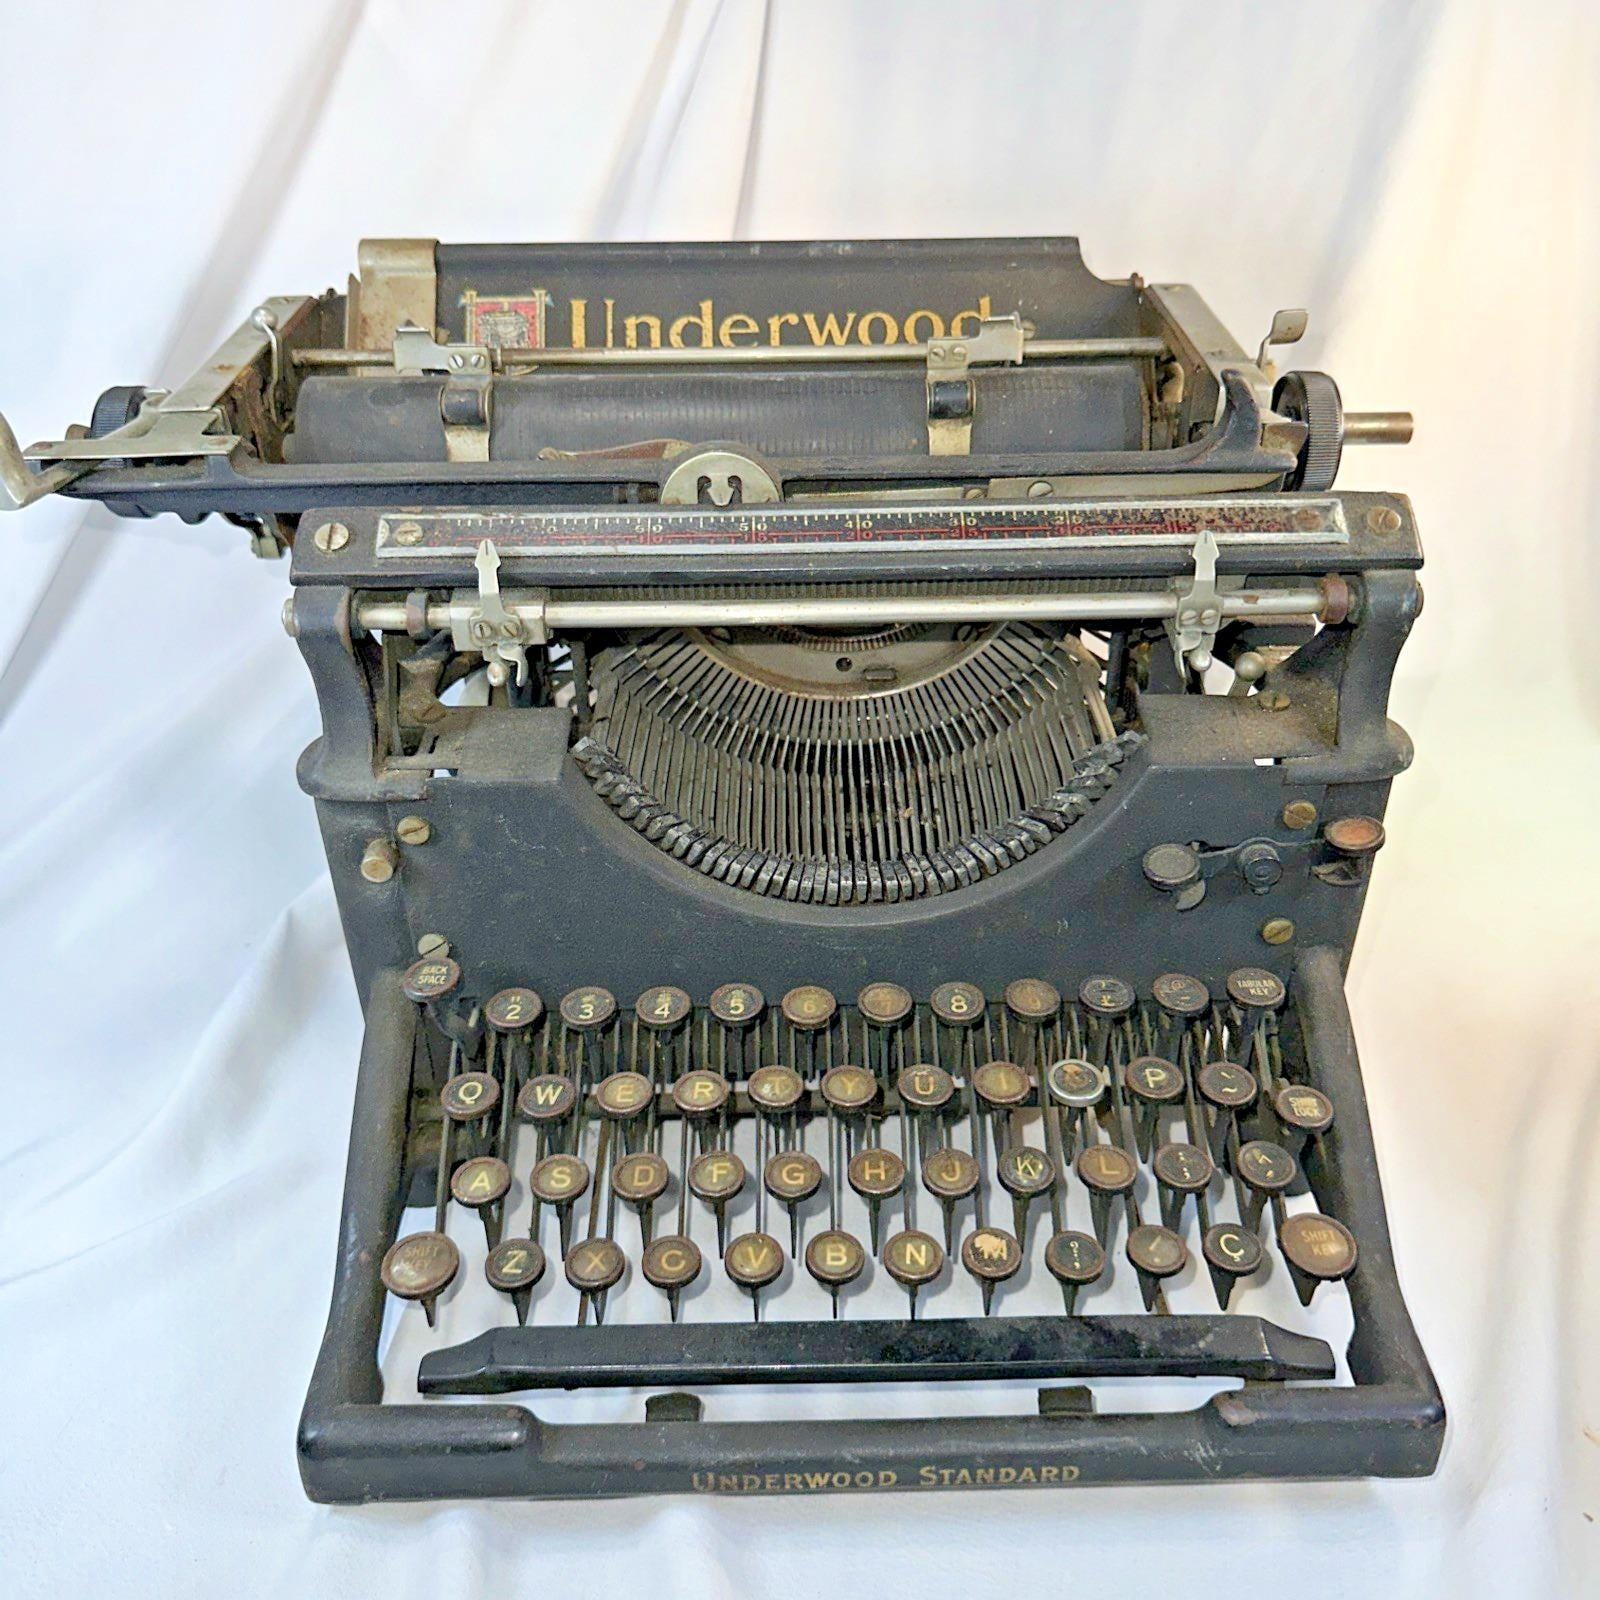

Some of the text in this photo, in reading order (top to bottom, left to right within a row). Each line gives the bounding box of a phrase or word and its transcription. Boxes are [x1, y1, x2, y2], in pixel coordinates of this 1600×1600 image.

[570, 297, 993, 349] Underwood
[739, 522, 767, 532] 50
[844, 520, 873, 529] 40
[417, 975, 447, 985] SPACE
[420, 965, 448, 976] BACK
[505, 1005, 520, 1020] 2
[579, 1004, 594, 1020] 3
[653, 1002, 670, 1019] 4
[729, 999, 745, 1014] 5
[802, 1000, 816, 1012] 6
[951, 994, 967, 1012] 8
[767, 1076, 787, 1095] T
[841, 1077, 861, 1094] Y
[1144, 1068, 1166, 1088] P
[458, 1081, 483, 1104] Q
[535, 1085, 564, 1105] W
[616, 1083, 635, 1102] E
[692, 1082, 714, 1099] R
[711, 1162, 730, 1183] F
[782, 1163, 804, 1184] G
[863, 1160, 885, 1181] H
[941, 1160, 961, 1181] J
[1016, 1156, 1038, 1177] K
[1099, 1155, 1120, 1174] L
[469, 1170, 491, 1191] A
[550, 1167, 571, 1188] S
[632, 1166, 654, 1186] D
[1301, 1229, 1336, 1245] SHIFT
[502, 1250, 528, 1274] Z
[584, 1250, 607, 1273] X
[661, 1250, 685, 1271] C
[748, 1246, 769, 1269] V
[826, 1243, 847, 1265] B
[905, 1243, 926, 1266] N
[693, 1465, 1081, 1492] UNDERWOOD STANDARD
